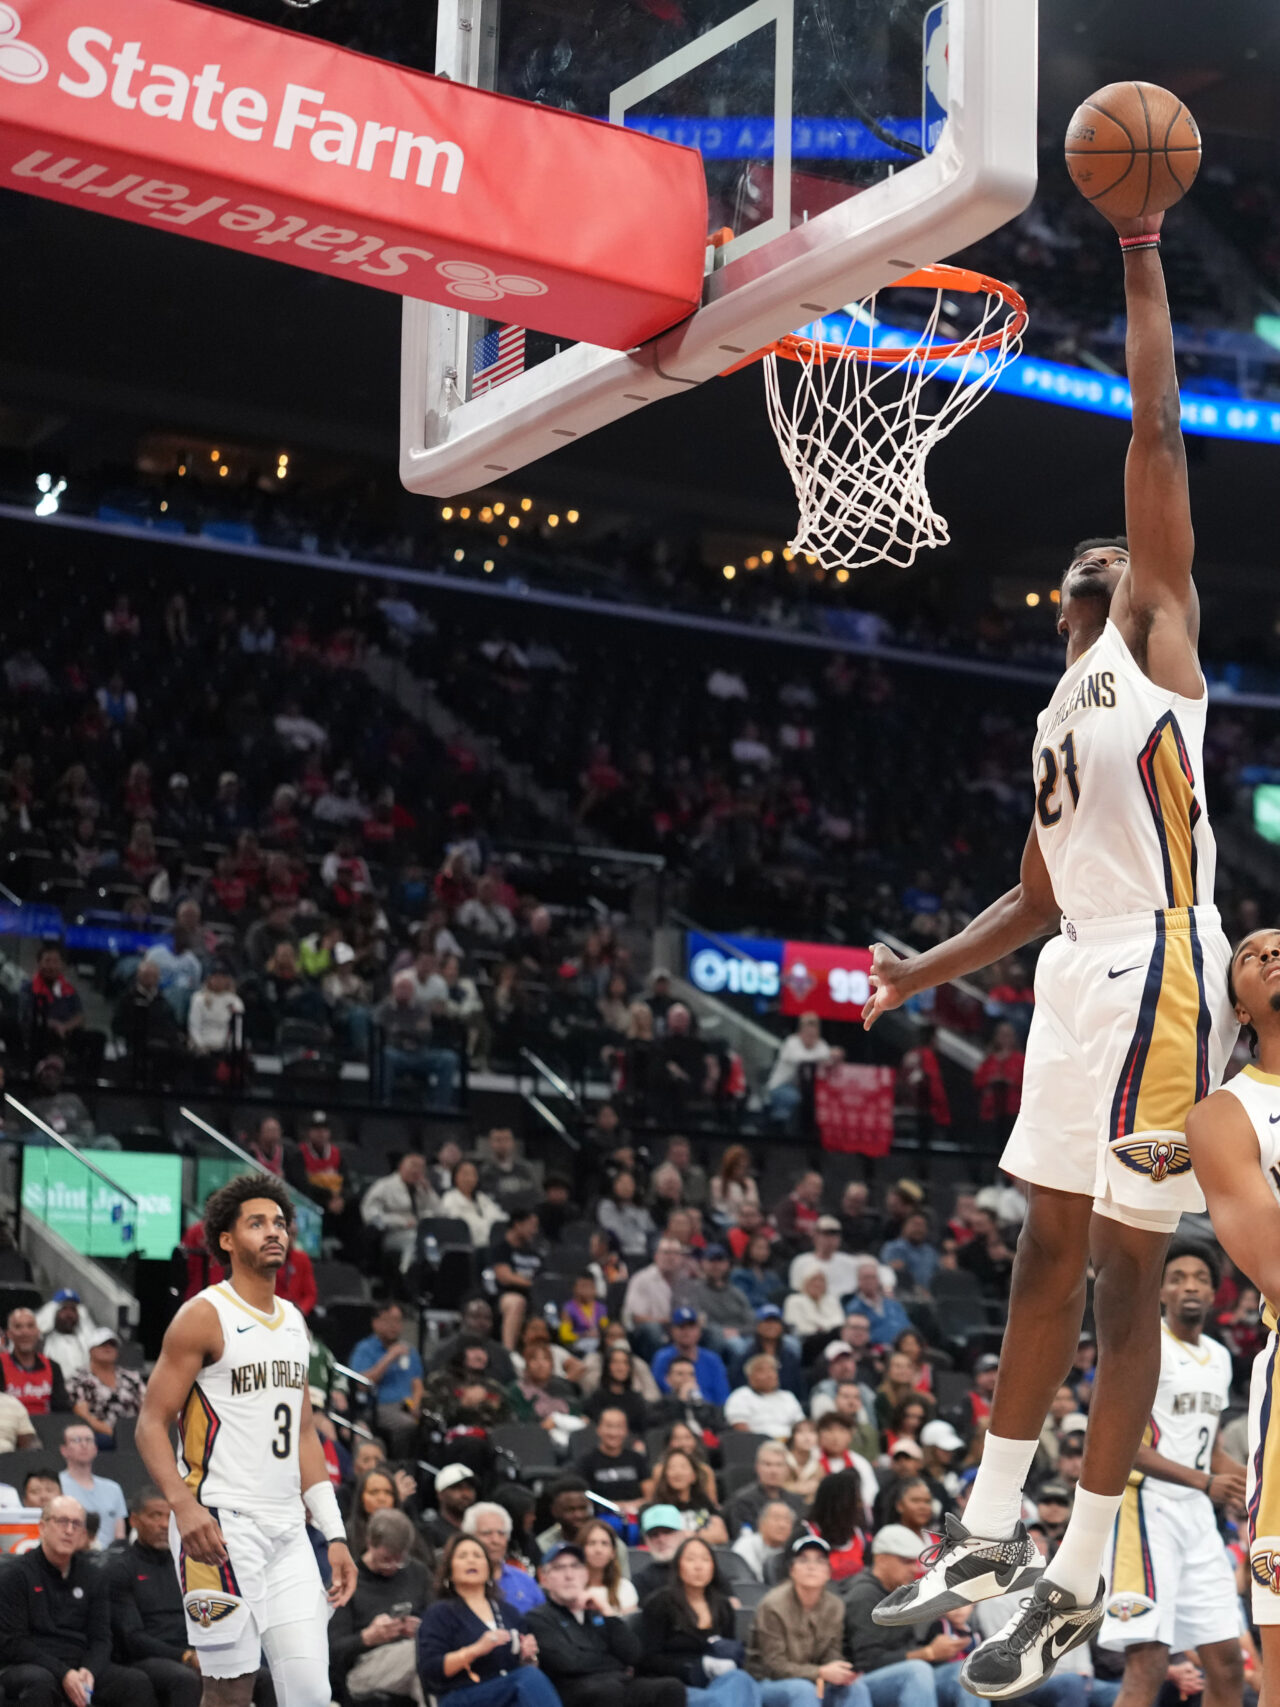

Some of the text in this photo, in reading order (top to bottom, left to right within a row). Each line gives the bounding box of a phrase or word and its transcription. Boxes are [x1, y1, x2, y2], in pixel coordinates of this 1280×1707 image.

[1022, 366, 1103, 402] PROUD
[1037, 729, 1081, 829] 21
[726, 958, 780, 996] 105
[231, 1361, 267, 1396] NEW
[272, 1402, 292, 1460] 3
[1195, 1426, 1209, 1471] 2
